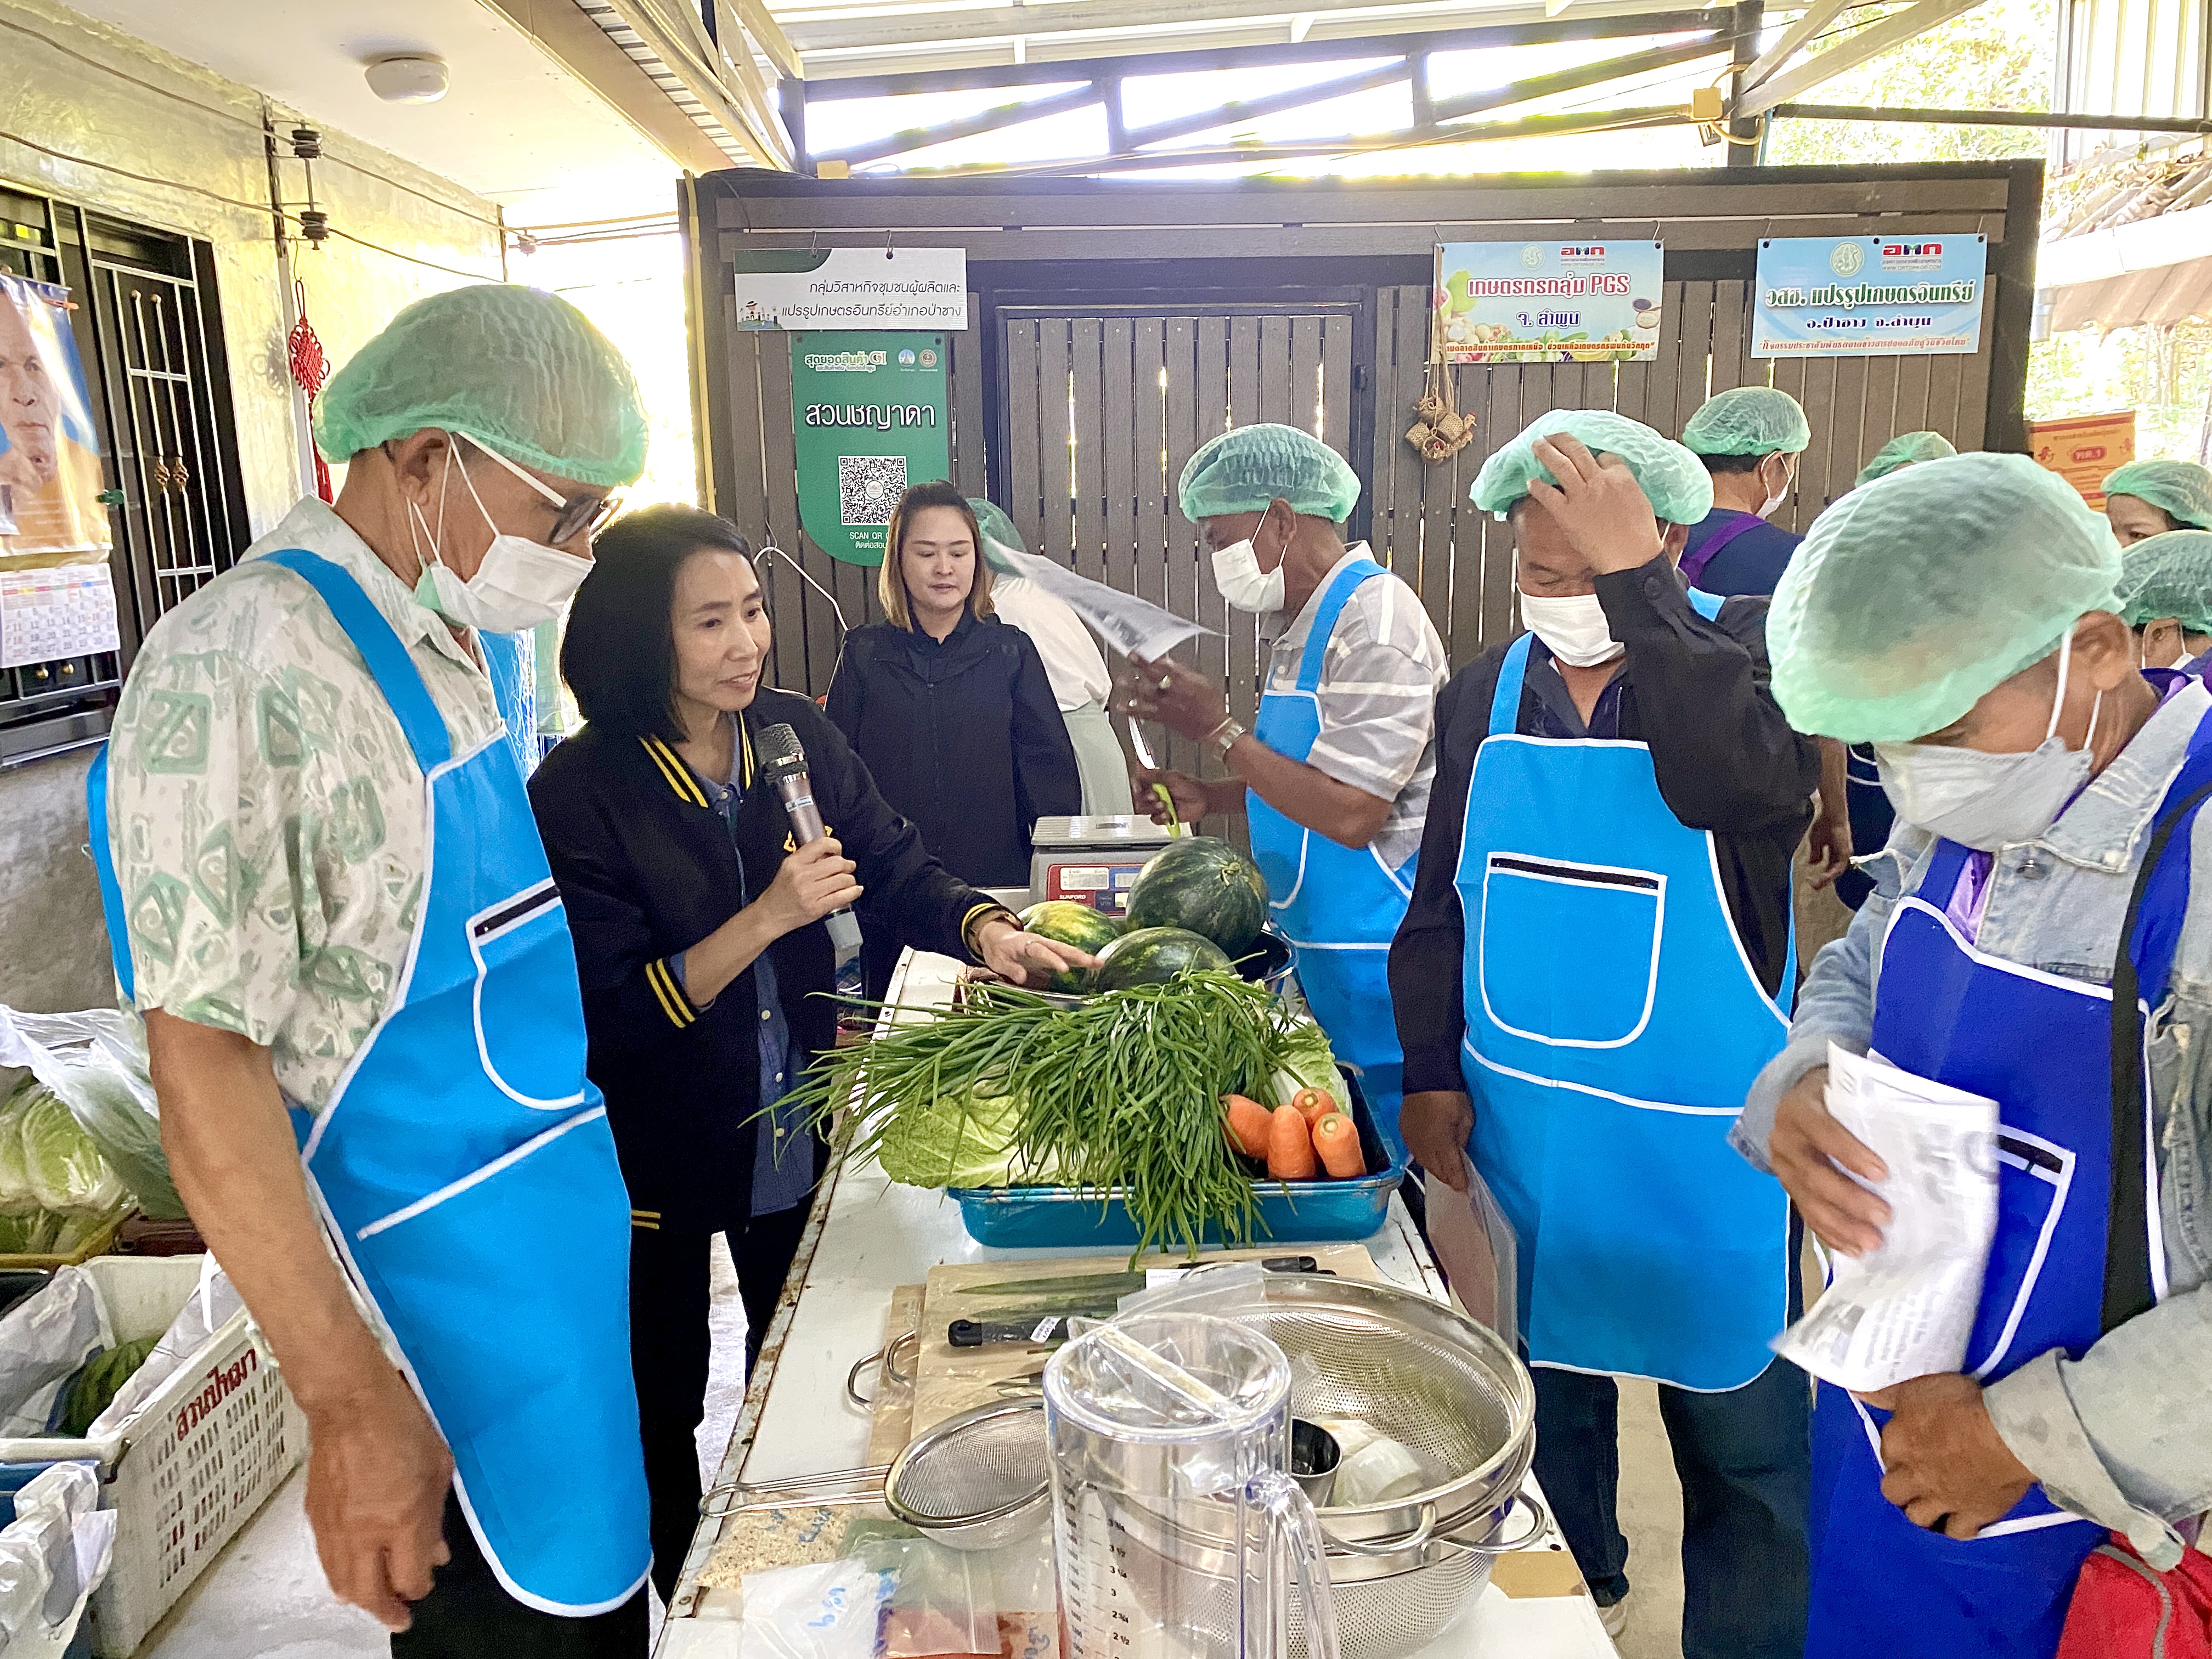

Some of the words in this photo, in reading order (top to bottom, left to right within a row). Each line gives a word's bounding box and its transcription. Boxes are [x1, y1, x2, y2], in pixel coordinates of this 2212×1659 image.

[809, 279, 960, 296] กลุ่มวิสาหกิจชุมชนผู้ผลิตและ
[1469, 272, 1585, 296] เกษตรกรกลุ่ม
[1591, 275, 1629, 293] PGS
[1812, 280, 1975, 308] แปรรูปเกษตรอินทรีย์
[782, 302, 961, 319] แปรรูปเกษตรอินทรีย์อำเภอป่าซาง
[1518, 313, 1532, 326] จ.
[1538, 310, 1579, 328] ลำพูน
[806, 403, 935, 430] สวนชญาดา
[849, 532, 869, 540] SCAN
[872, 532, 883, 540] QR
[1109, 1565, 1115, 1574] 3
[1111, 1588, 1117, 1597] 3
[1112, 1610, 1118, 1619] 2
[1113, 1632, 1119, 1641] 2
